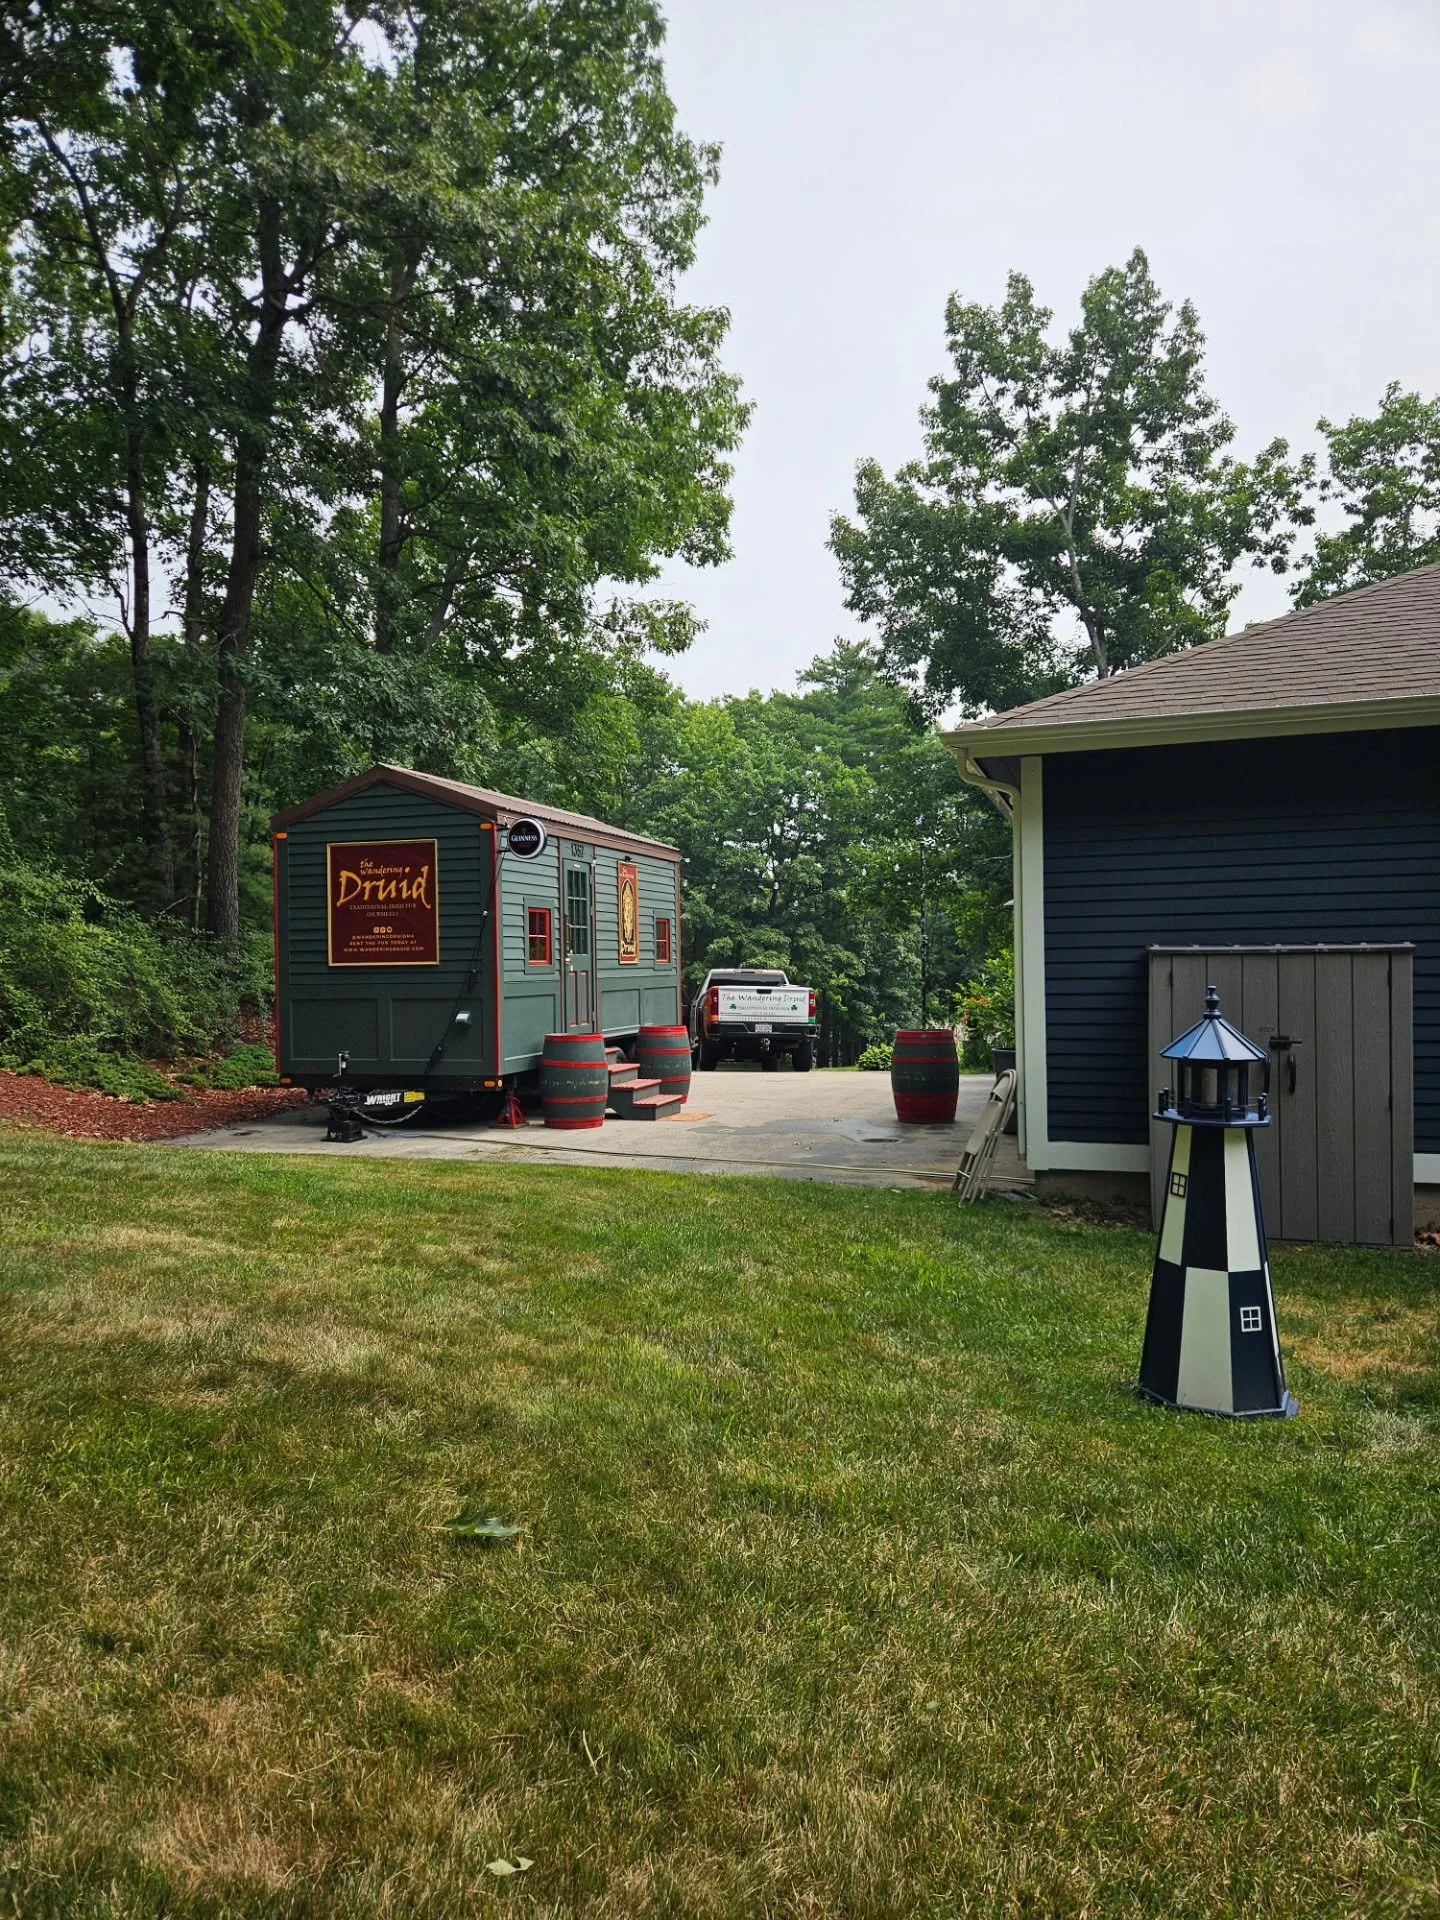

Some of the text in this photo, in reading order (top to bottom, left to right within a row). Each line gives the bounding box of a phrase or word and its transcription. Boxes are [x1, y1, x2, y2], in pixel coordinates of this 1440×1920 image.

[511, 834, 538, 842] GUINNESS
[360, 858, 374, 868] the
[360, 865, 403, 878] wandering
[336, 865, 431, 909] Druid
[364, 1092, 402, 1106] WRIGHT
